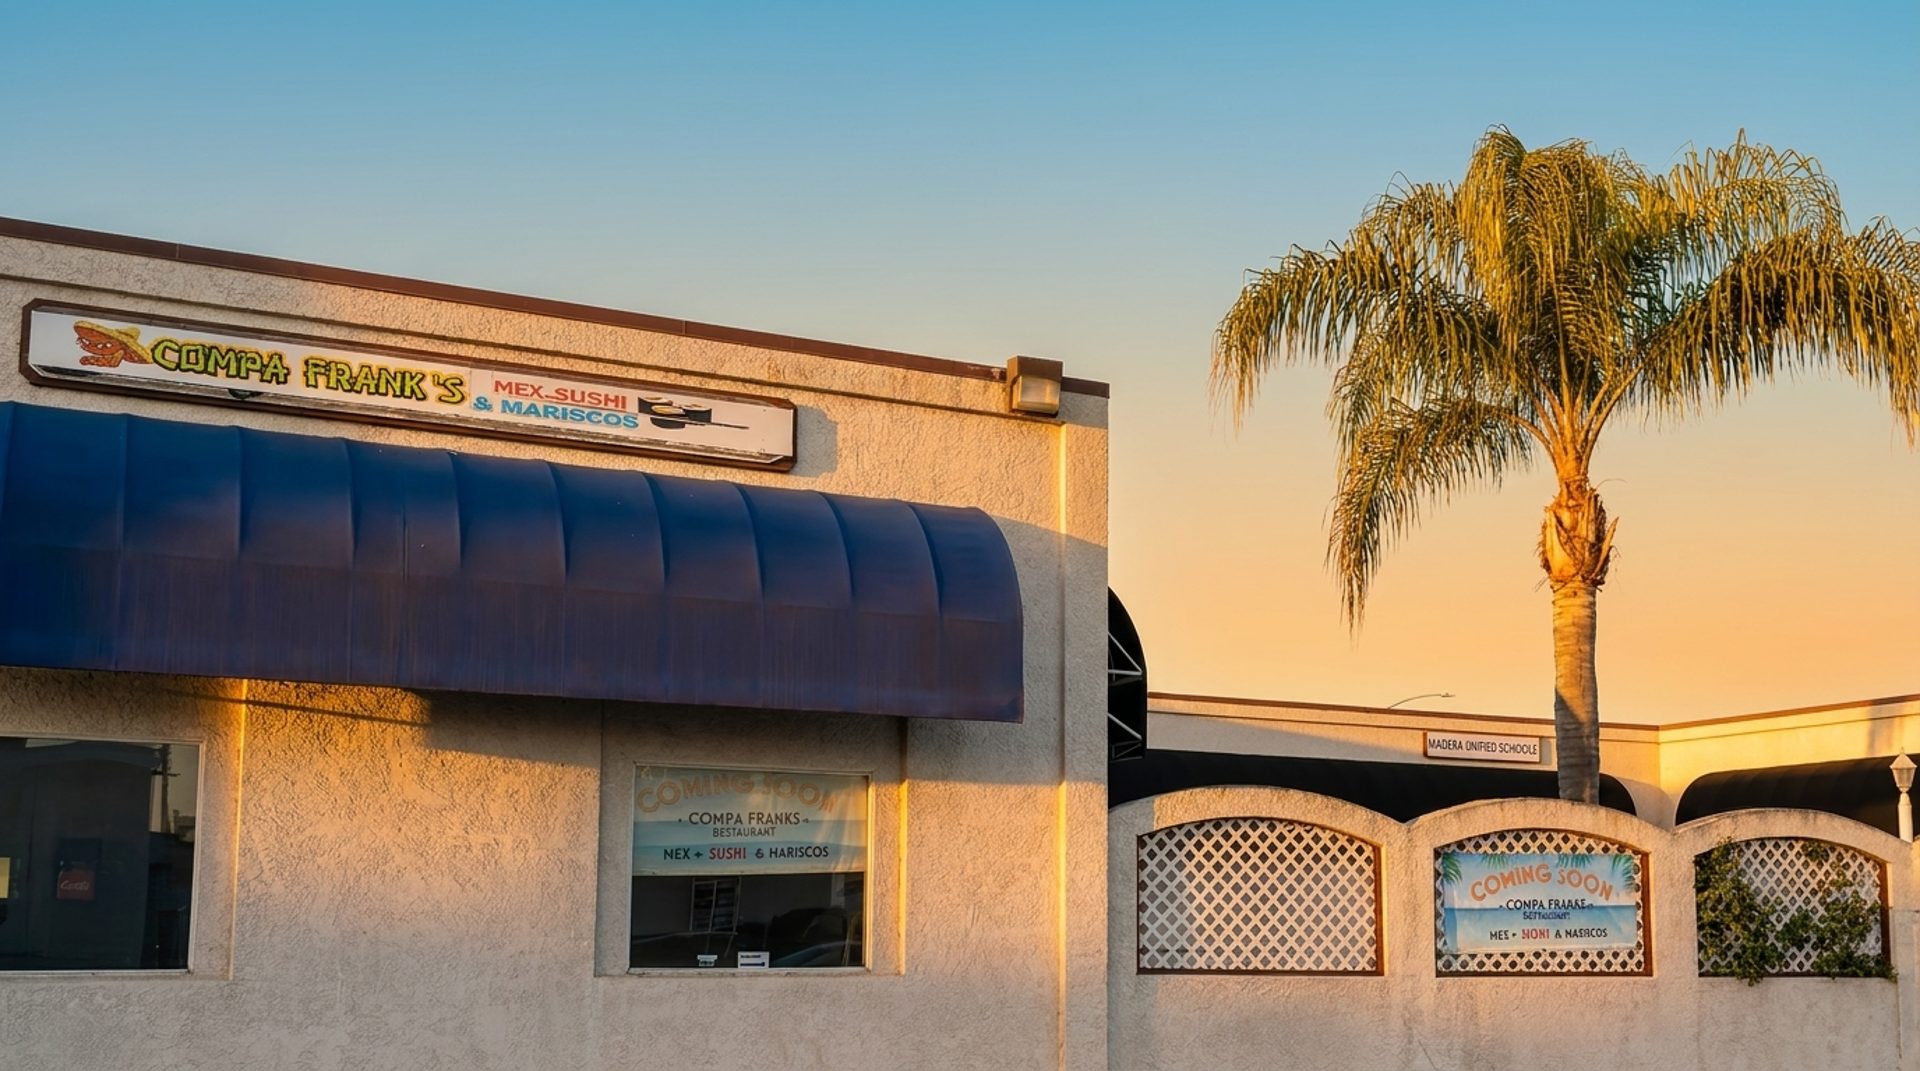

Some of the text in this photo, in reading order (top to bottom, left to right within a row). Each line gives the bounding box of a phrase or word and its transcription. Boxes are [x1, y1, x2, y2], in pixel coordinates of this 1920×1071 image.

[152, 339, 464, 404] COMPA FRANK'S
[473, 396, 639, 429] & MARISCOS
[1428, 738, 1463, 751] MADERA
[637, 773, 755, 813] COMING
[688, 812, 800, 825] COMPA FRANKS
[709, 847, 746, 859] SUSHI
[769, 846, 829, 858] HARISCOS
[1470, 864, 1613, 901] COMING SOON
